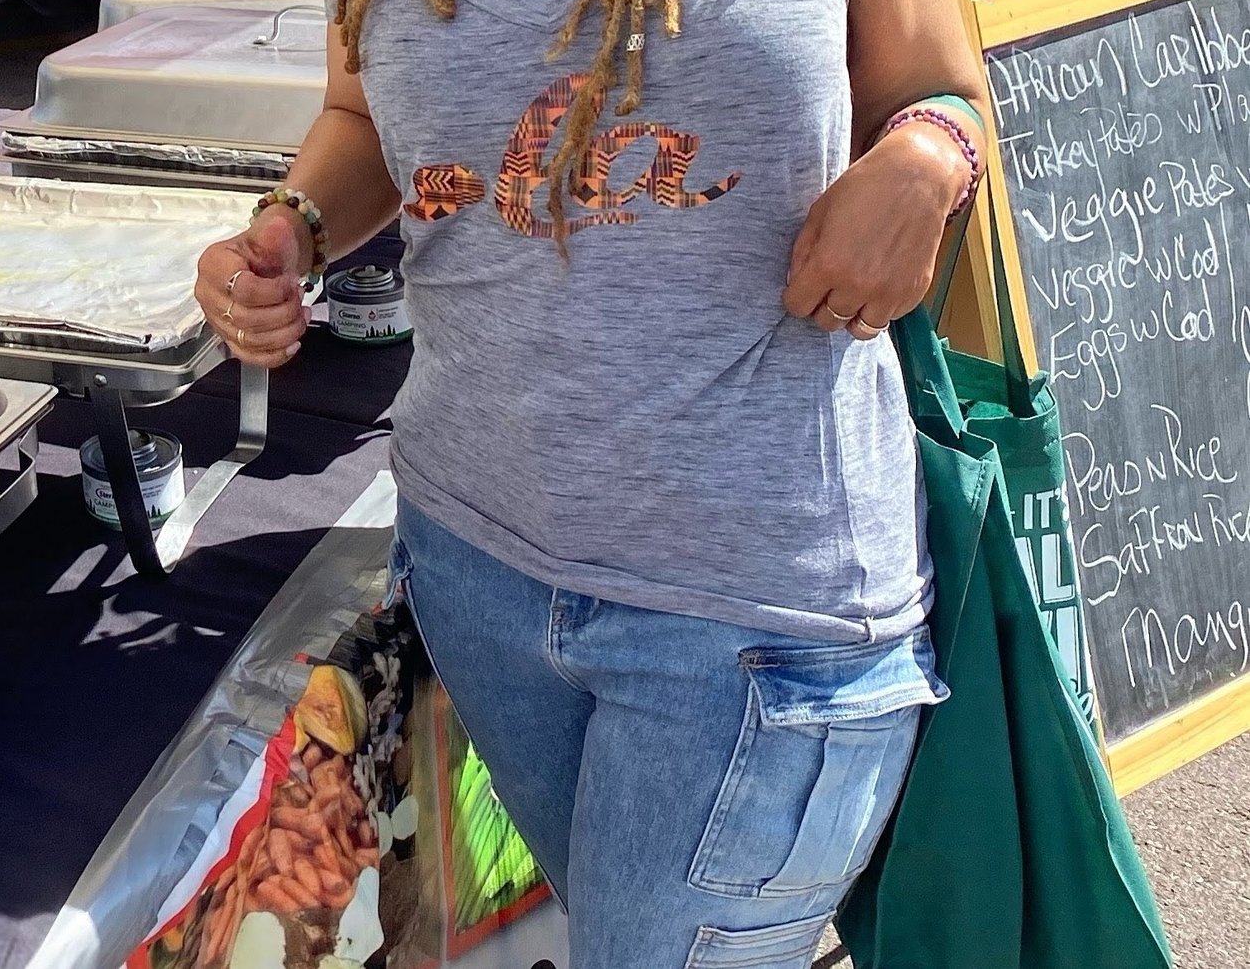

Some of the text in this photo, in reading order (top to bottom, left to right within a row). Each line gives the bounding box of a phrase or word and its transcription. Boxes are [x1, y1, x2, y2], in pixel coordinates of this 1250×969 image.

[1022, 177, 1163, 262] Veggie
[1050, 322, 1127, 411] Eggs
[1061, 433, 1142, 516] Peas
[1151, 404, 1237, 483] Rice
[1122, 601, 1250, 688] Mang
